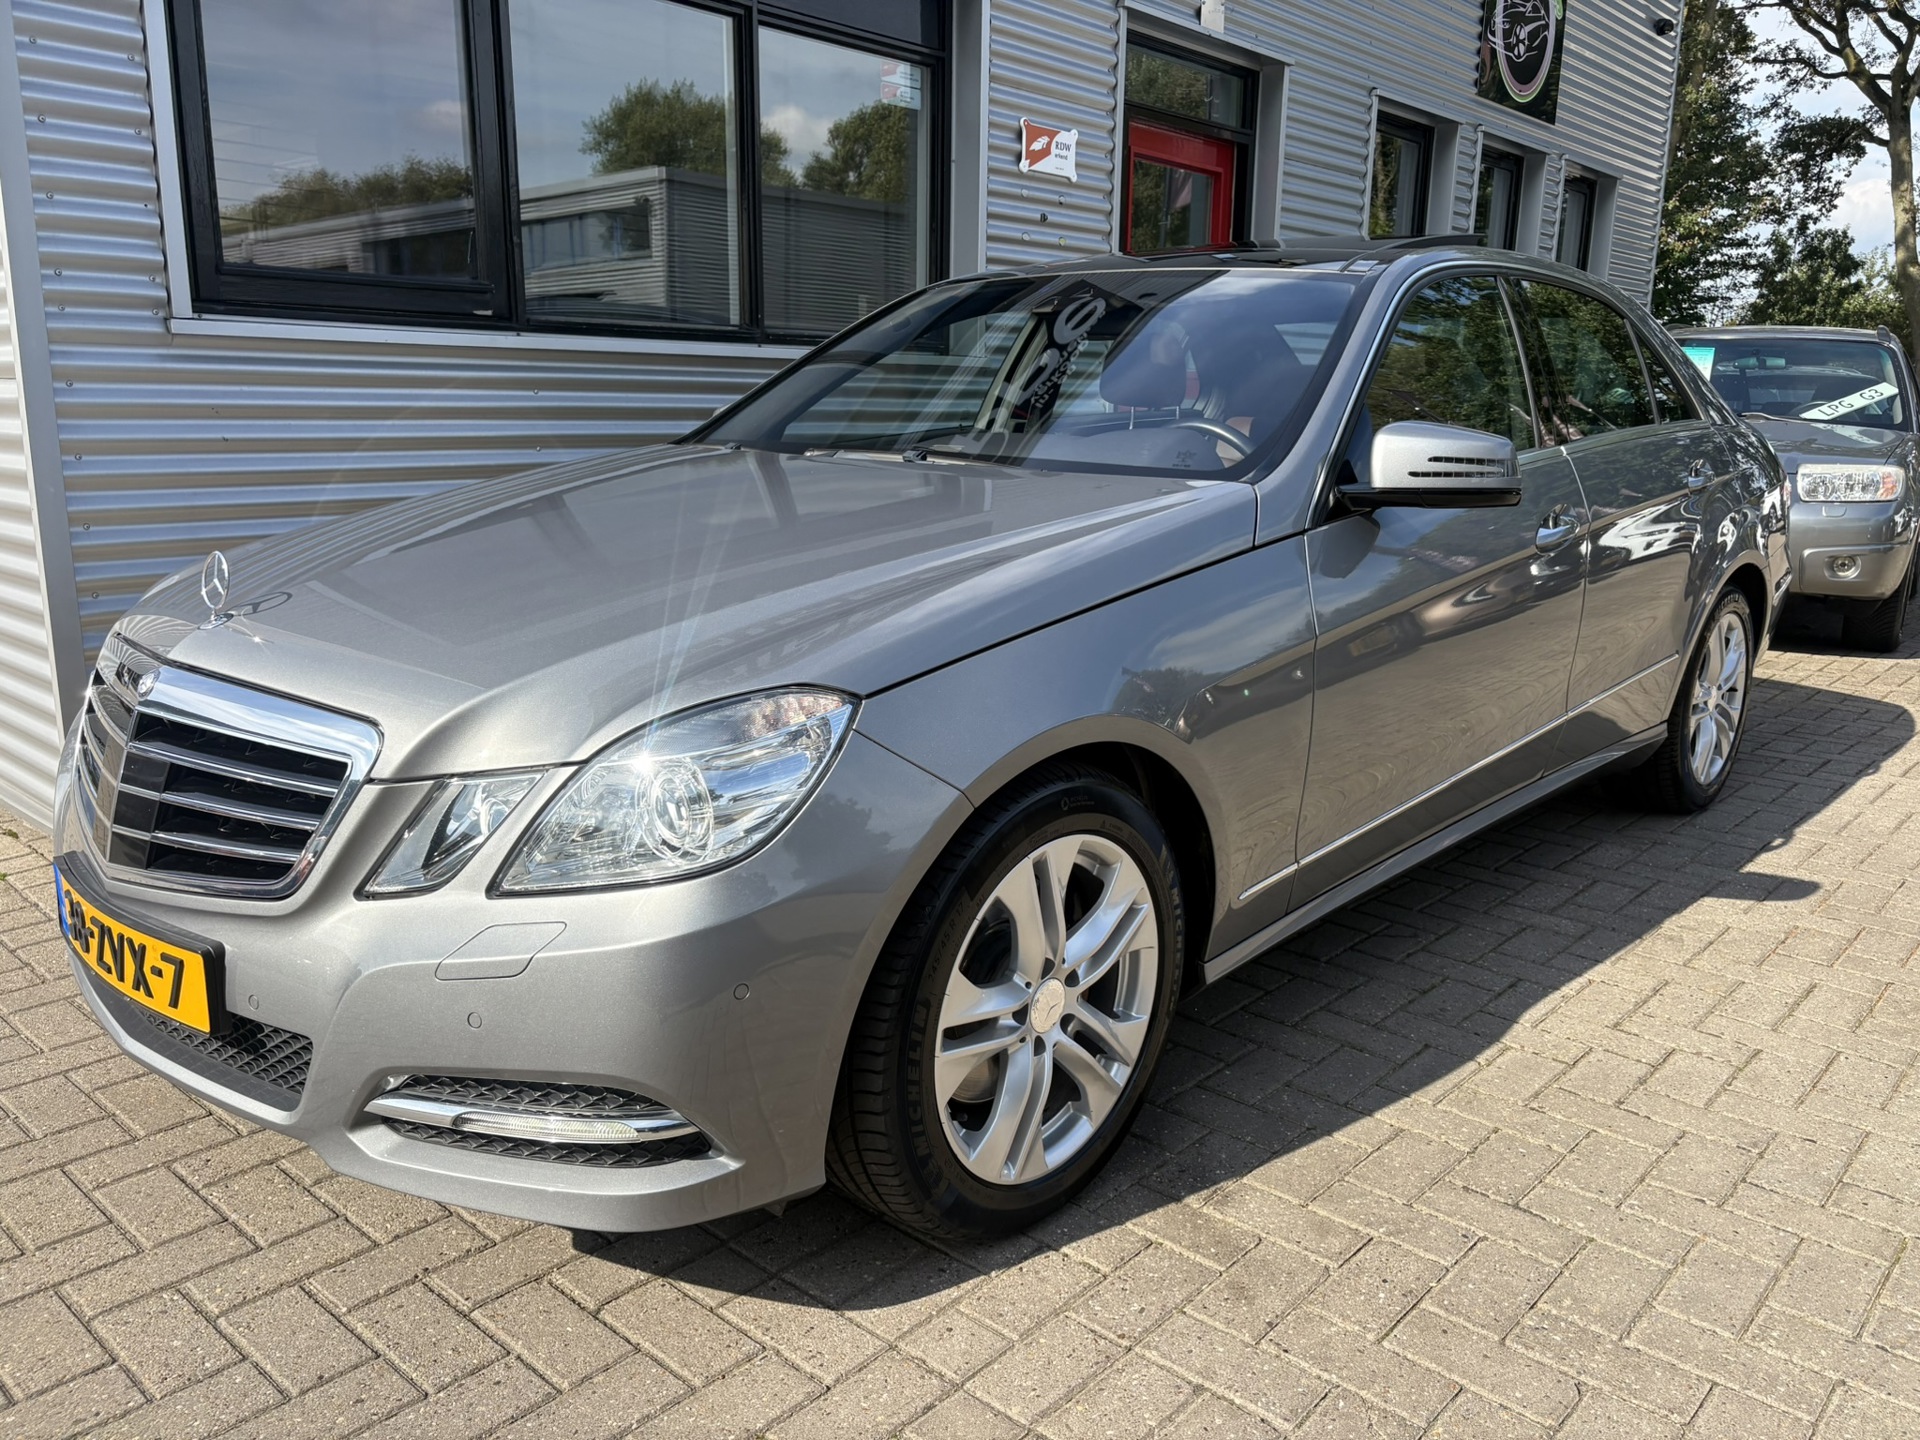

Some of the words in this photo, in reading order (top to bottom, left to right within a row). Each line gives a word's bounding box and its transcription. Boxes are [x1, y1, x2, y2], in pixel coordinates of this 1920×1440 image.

[1055, 141, 1072, 152] RDW
[1817, 399, 1855, 417] LPG
[1859, 388, 1884, 401] G3
[907, 1002, 931, 1157] MICHELIN
